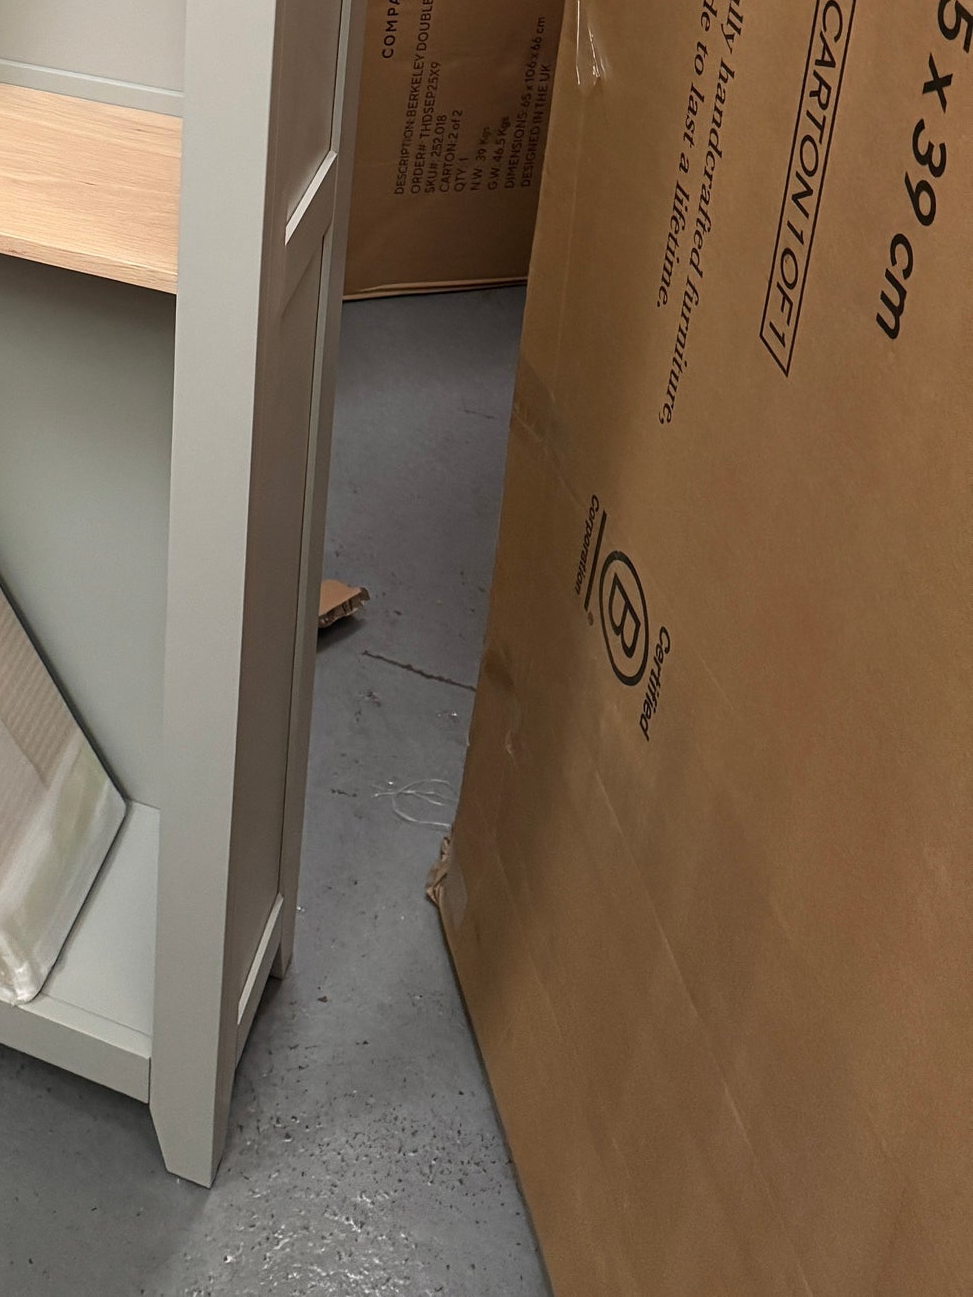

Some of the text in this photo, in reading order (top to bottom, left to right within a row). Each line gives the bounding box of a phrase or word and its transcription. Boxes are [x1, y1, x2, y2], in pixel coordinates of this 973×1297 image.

[530, 36, 543, 52] 66
[536, 16, 546, 34] cm
[406, 53, 426, 119] BERKELEY
[524, 62, 537, 83] 106
[539, 64, 551, 83] UK
[694, 40, 709, 77] to
[534, 85, 548, 109] THE
[683, 81, 705, 149] last
[520, 125, 541, 188] DESIGNED
[679, 151, 691, 174] a
[690, 56, 735, 278] handcrafted
[876, 52, 953, 341] x 39 cm
[656, 179, 691, 308] lifetime.
[785, 219, 805, 246] 1
[776, 246, 799, 327] OF
[658, 274, 701, 426] furniture,
[769, 320, 786, 349] 1
[575, 494, 600, 595] Corporation
[639, 626, 671, 742] Certified
